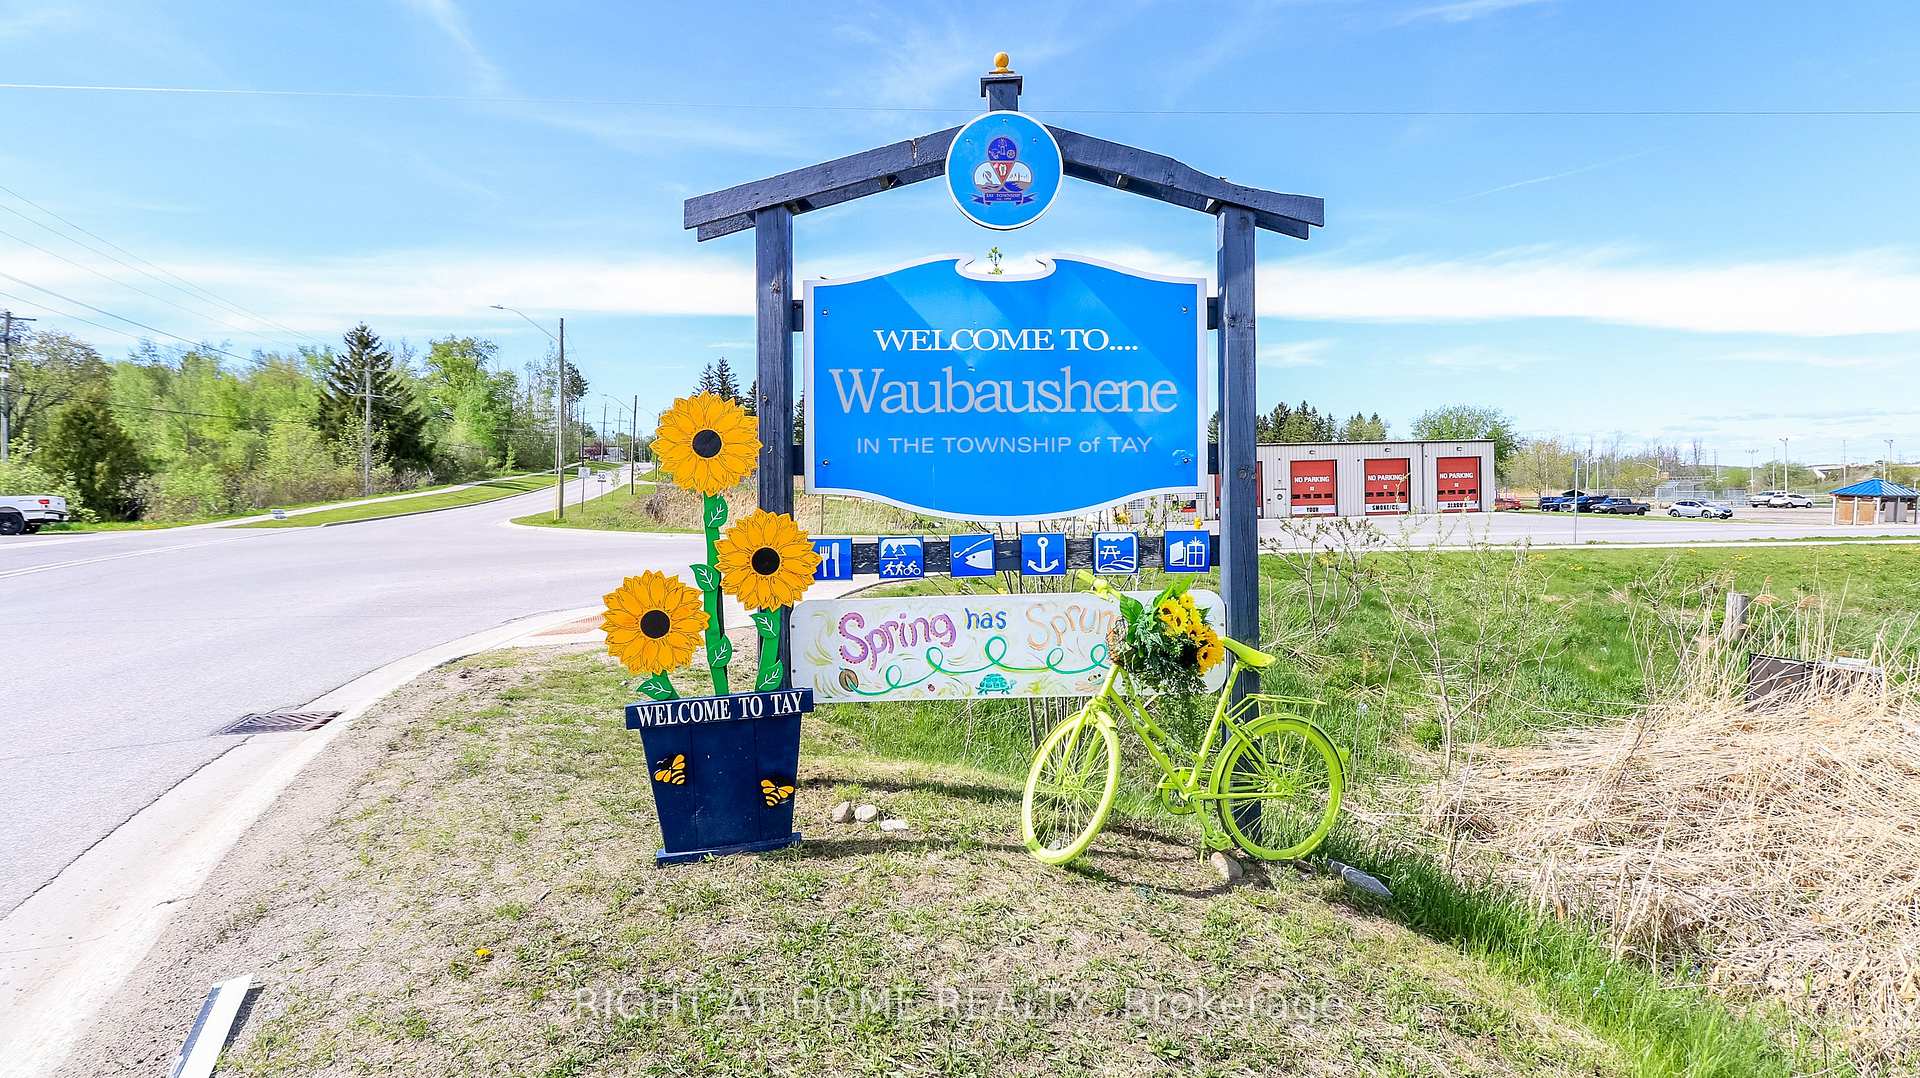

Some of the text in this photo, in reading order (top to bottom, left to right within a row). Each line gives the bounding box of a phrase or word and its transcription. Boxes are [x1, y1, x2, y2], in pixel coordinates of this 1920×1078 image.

[873, 328, 1139, 351] WELCOME TO....
[829, 365, 1178, 414] Waubaushene
[857, 435, 1153, 455] IN THE TOWNSHIP of TAY
[1304, 475, 1330, 483] PARKING
[837, 602, 1117, 671] Spring has Sprun
[636, 691, 803, 727] WELCOME TO TAY
